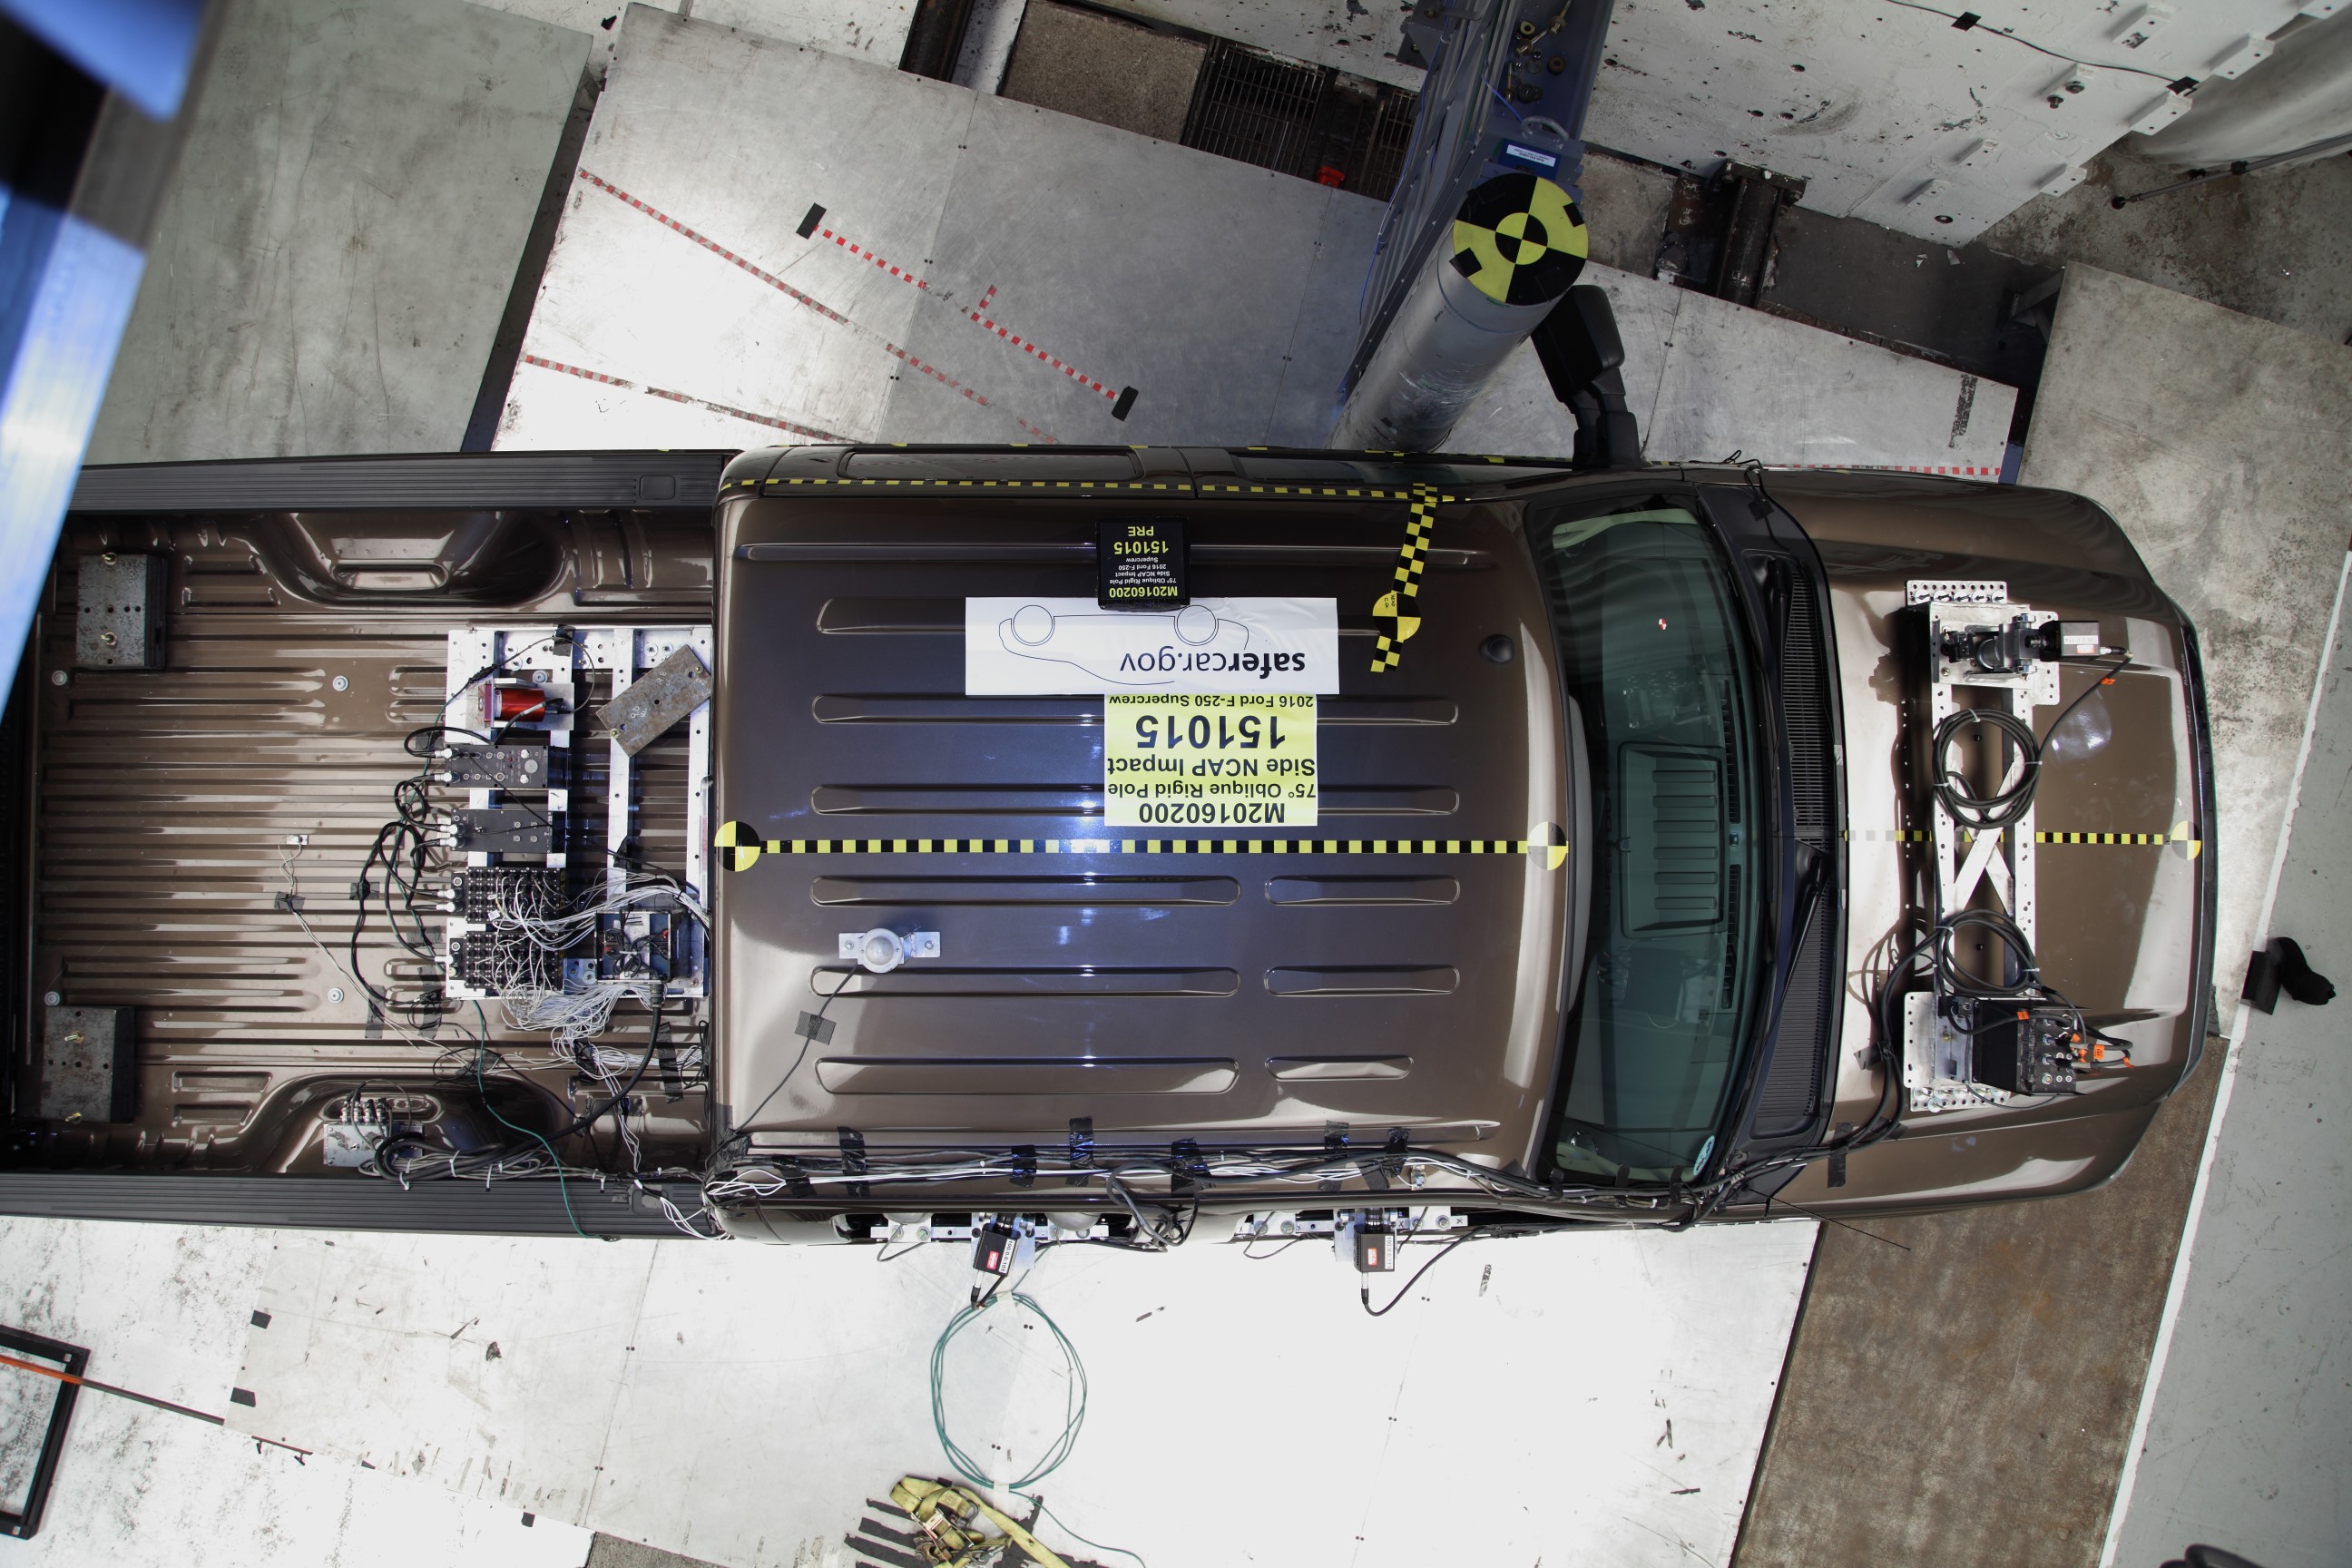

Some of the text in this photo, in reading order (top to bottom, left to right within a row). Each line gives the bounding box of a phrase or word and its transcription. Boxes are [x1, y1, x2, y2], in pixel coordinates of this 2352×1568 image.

[1127, 526, 1154, 537] PRE
[1113, 541, 1169, 554] 151015
[1109, 586, 1178, 598] M20160200
[1120, 646, 1306, 679] safercar.gov
[1109, 694, 1314, 708] 2016 Ford F-250 Supercrew
[1136, 715, 1286, 749] 151015
[1107, 755, 1315, 776] Side NCAP Impact
[1107, 780, 1316, 798] 75° Oblique Rigid Pole
[1139, 803, 1285, 824] M20160200
